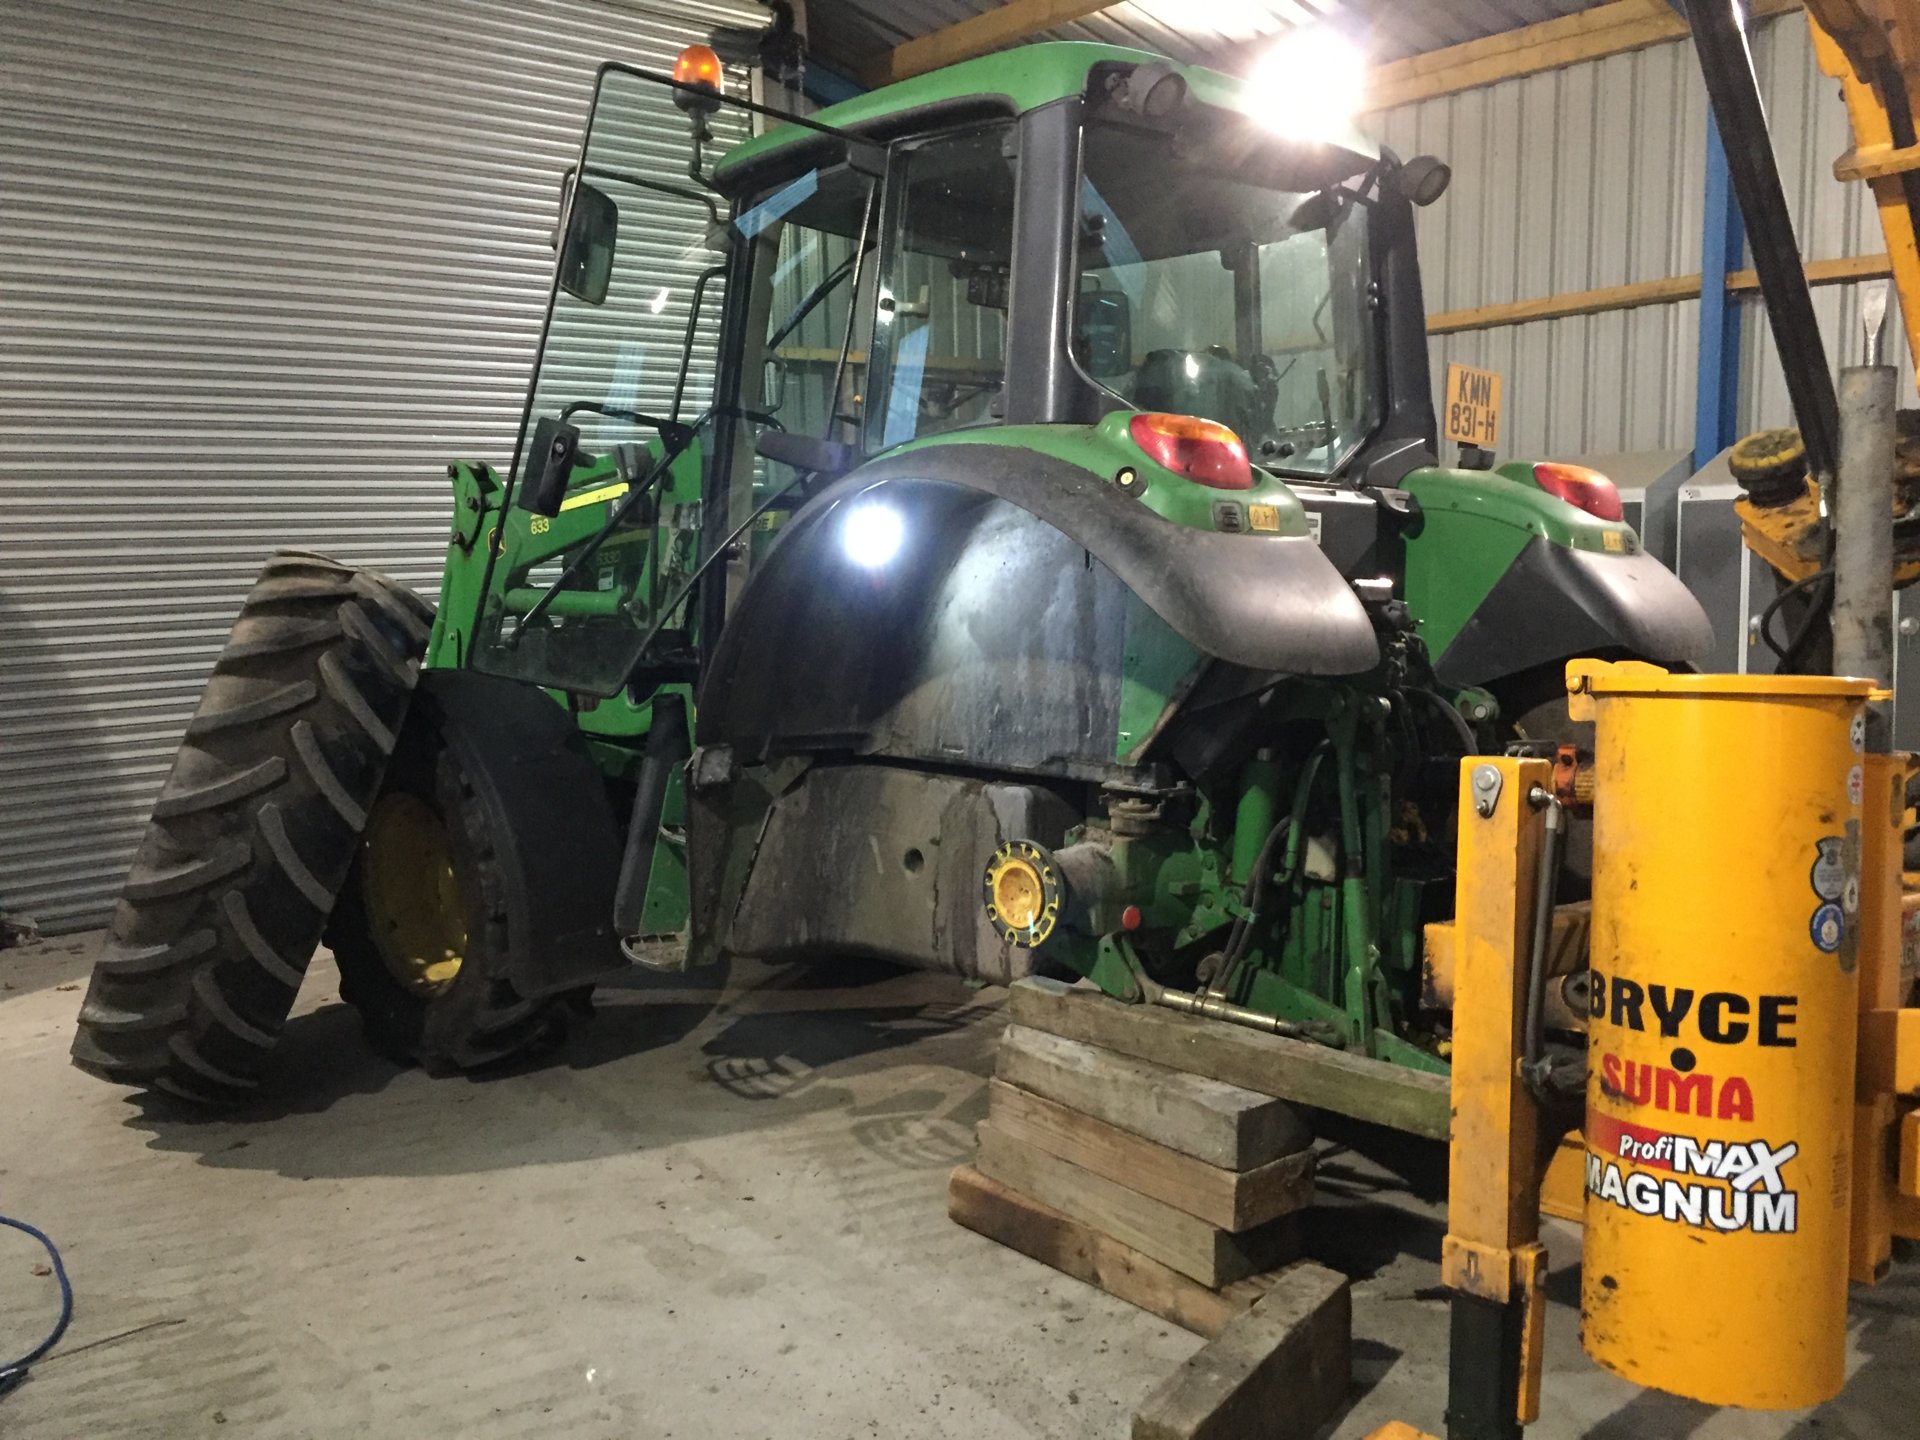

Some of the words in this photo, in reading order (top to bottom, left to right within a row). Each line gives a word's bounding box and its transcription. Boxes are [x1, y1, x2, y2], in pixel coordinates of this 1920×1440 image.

[1450, 402, 1496, 442] 831-H
[530, 518, 550, 535] 633
[1589, 968, 1798, 1048] BRYCE
[1601, 1053, 1755, 1123] SUMA
[1585, 1150, 1798, 1234] MAGNUM
